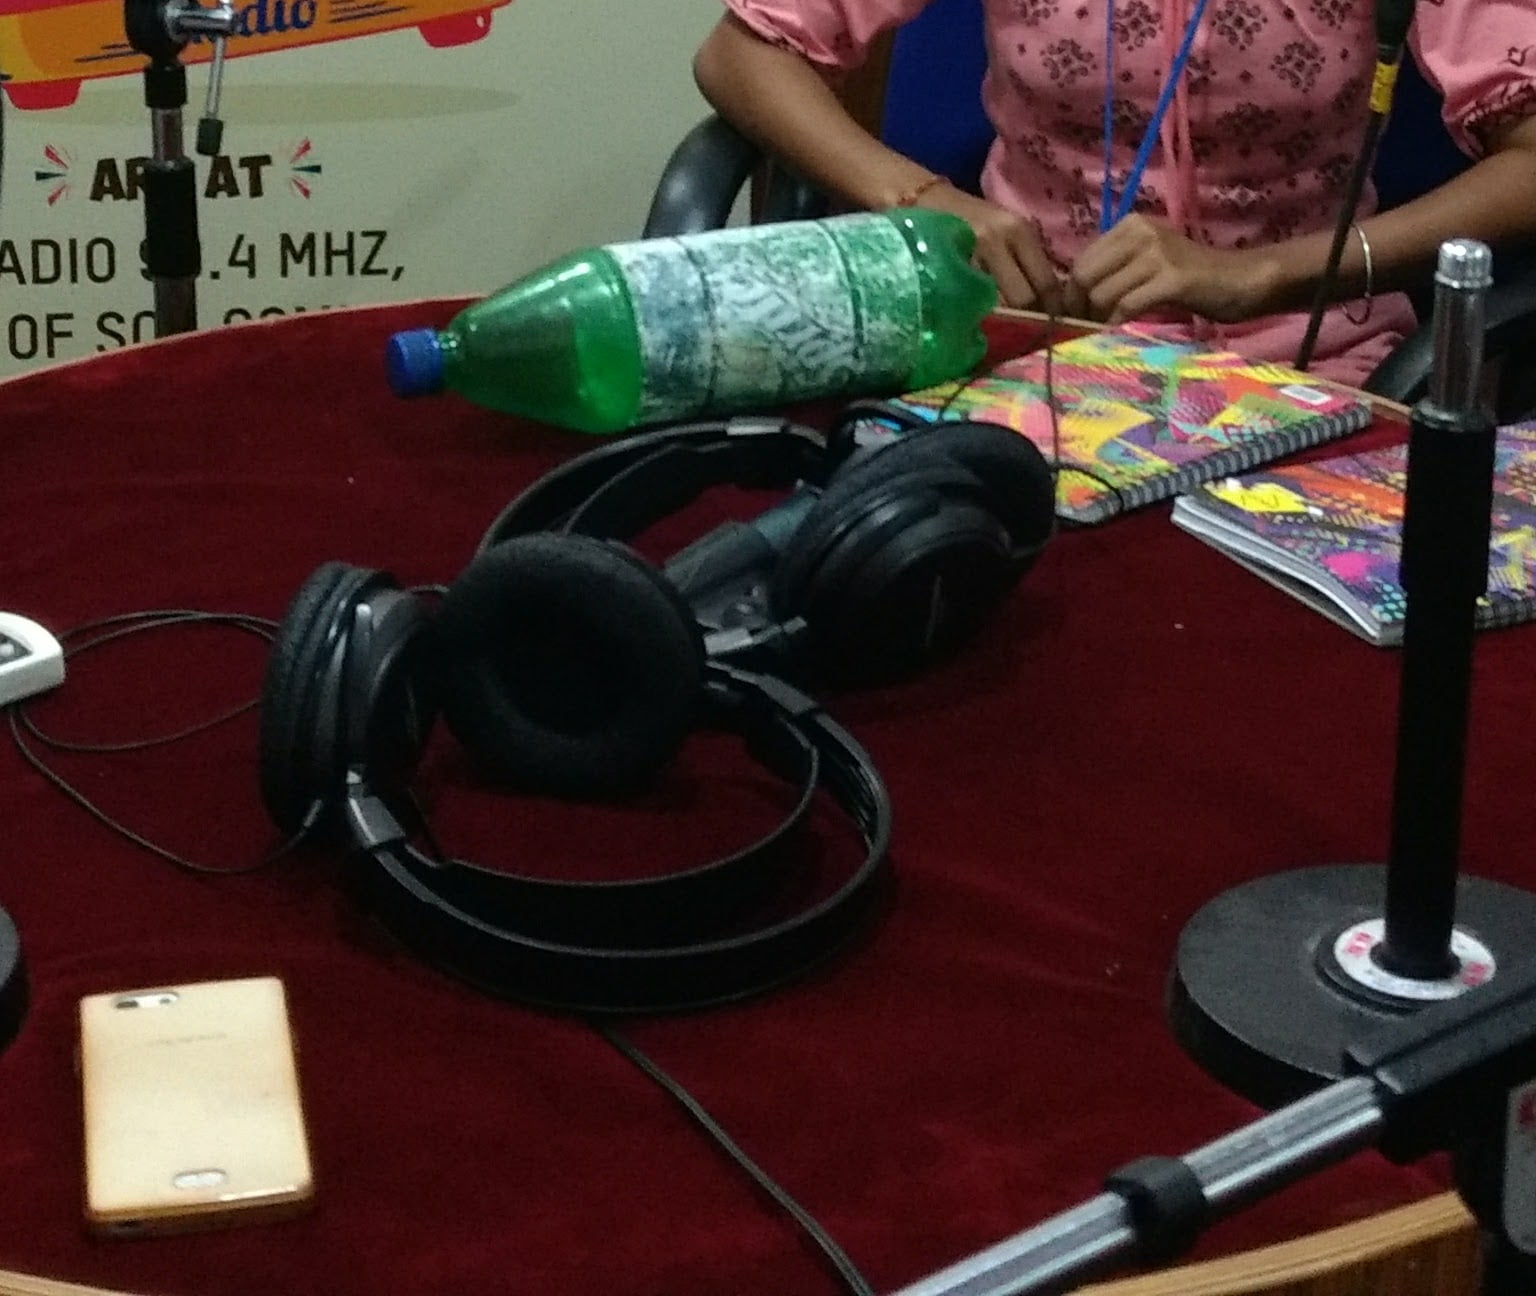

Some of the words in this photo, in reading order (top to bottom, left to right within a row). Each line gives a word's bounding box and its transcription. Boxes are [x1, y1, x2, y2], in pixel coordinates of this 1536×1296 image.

[205, 155, 272, 199] AT
[281, 230, 405, 281] MHZ,
[8, 312, 73, 359] OF
